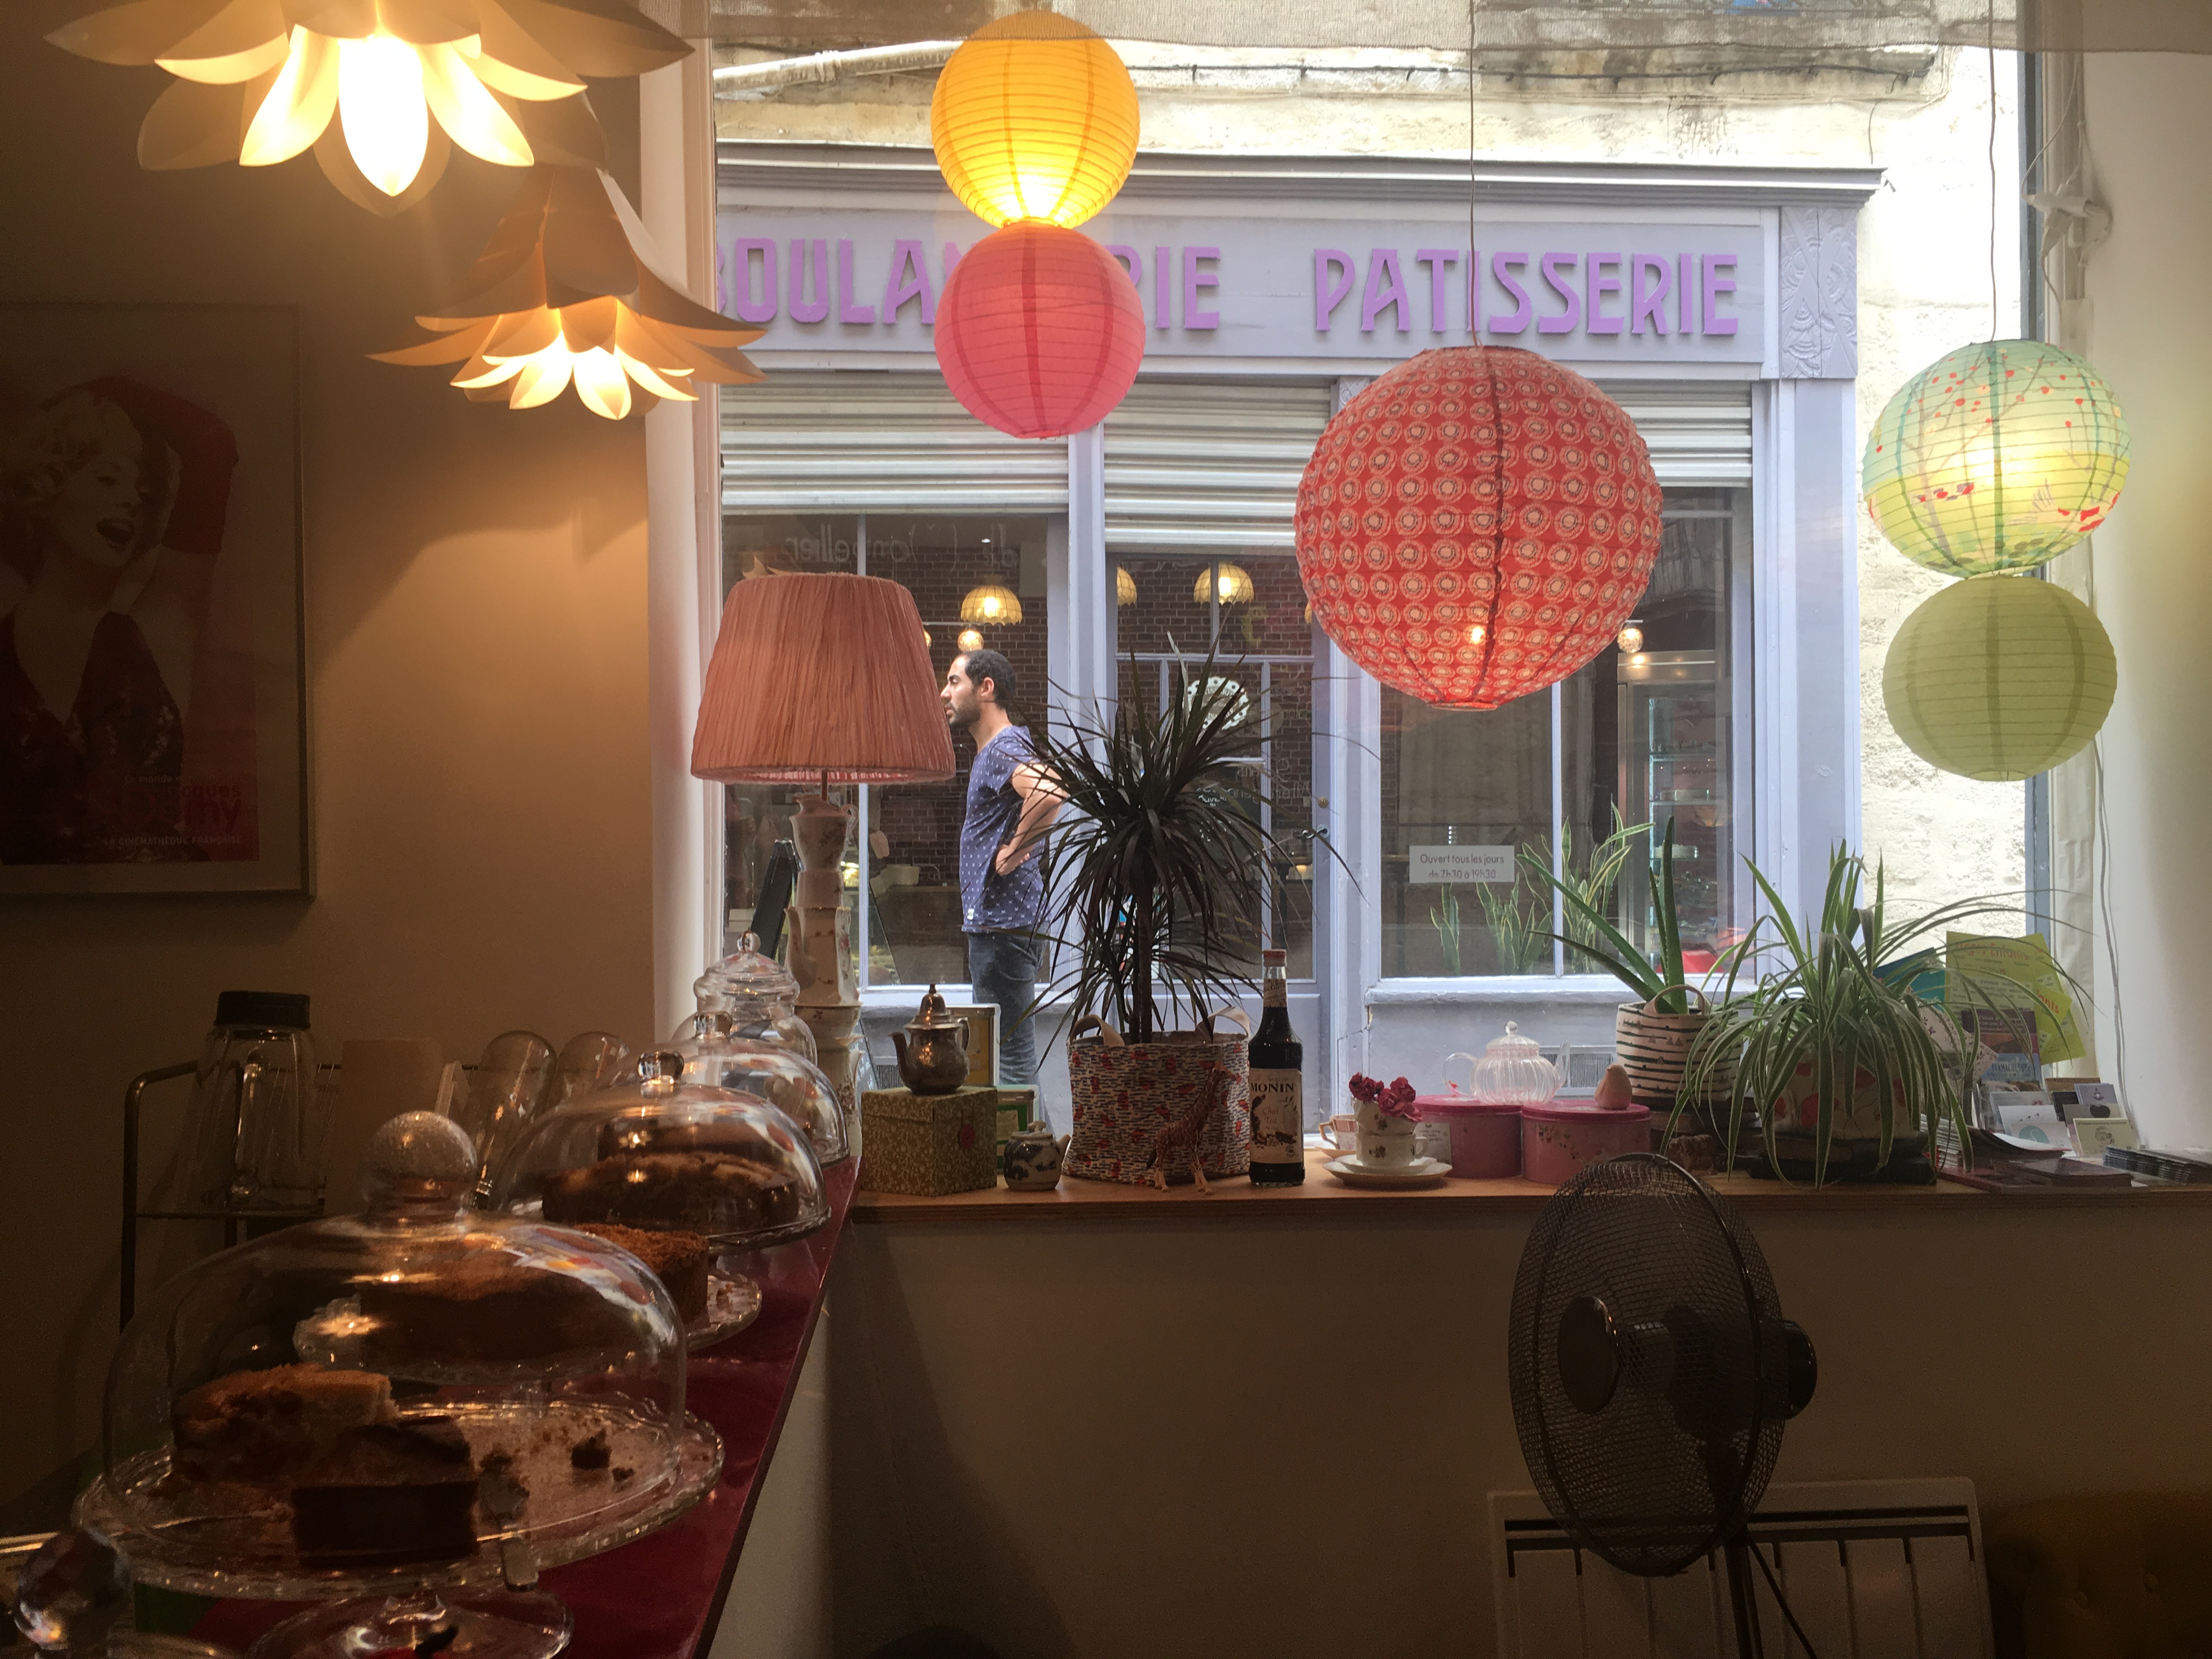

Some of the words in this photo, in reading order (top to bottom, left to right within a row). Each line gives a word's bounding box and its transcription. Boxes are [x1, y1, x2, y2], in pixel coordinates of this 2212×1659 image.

[716, 238, 1221, 330] OULAIE
[1313, 248, 1740, 335] PATISSERIE
[1420, 853, 1450, 864] Ouvert
[1452, 854, 1469, 864] tous
[1471, 853, 1482, 864] les
[1483, 854, 1504, 866] jours
[1441, 869, 1462, 879] 7h30
[1471, 869, 1497, 879] 19h30
[1250, 1082, 1294, 1093] MONIN
